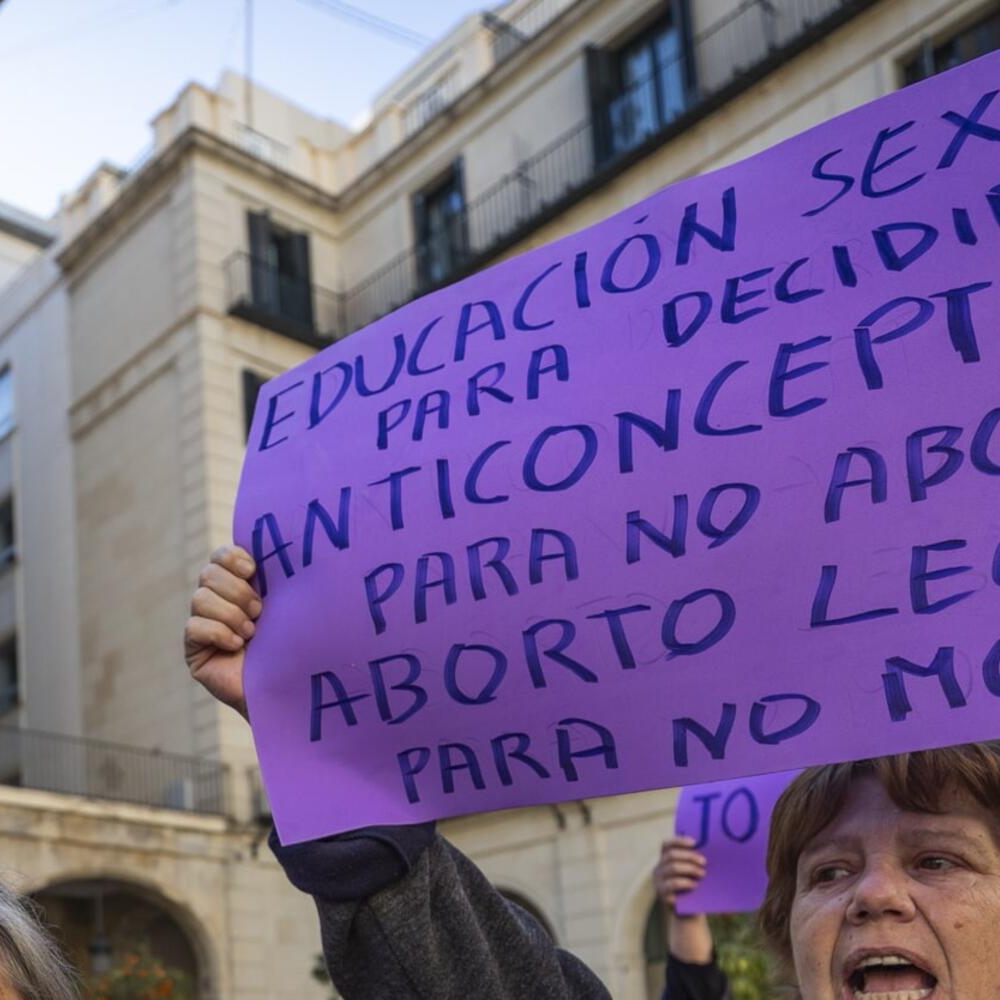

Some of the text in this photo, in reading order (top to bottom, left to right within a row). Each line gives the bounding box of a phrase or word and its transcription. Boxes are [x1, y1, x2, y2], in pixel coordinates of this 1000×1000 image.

[259, 90, 1000, 451] EDUCACIÓN SEX
[252, 282, 992, 599] ANTICONCEPT
[377, 345, 569, 449] PARA
[311, 540, 1000, 741] ABORTO LE
[364, 529, 578, 635] PARA
[627, 483, 760, 564] NO
[397, 640, 1000, 804] PARA NO M
